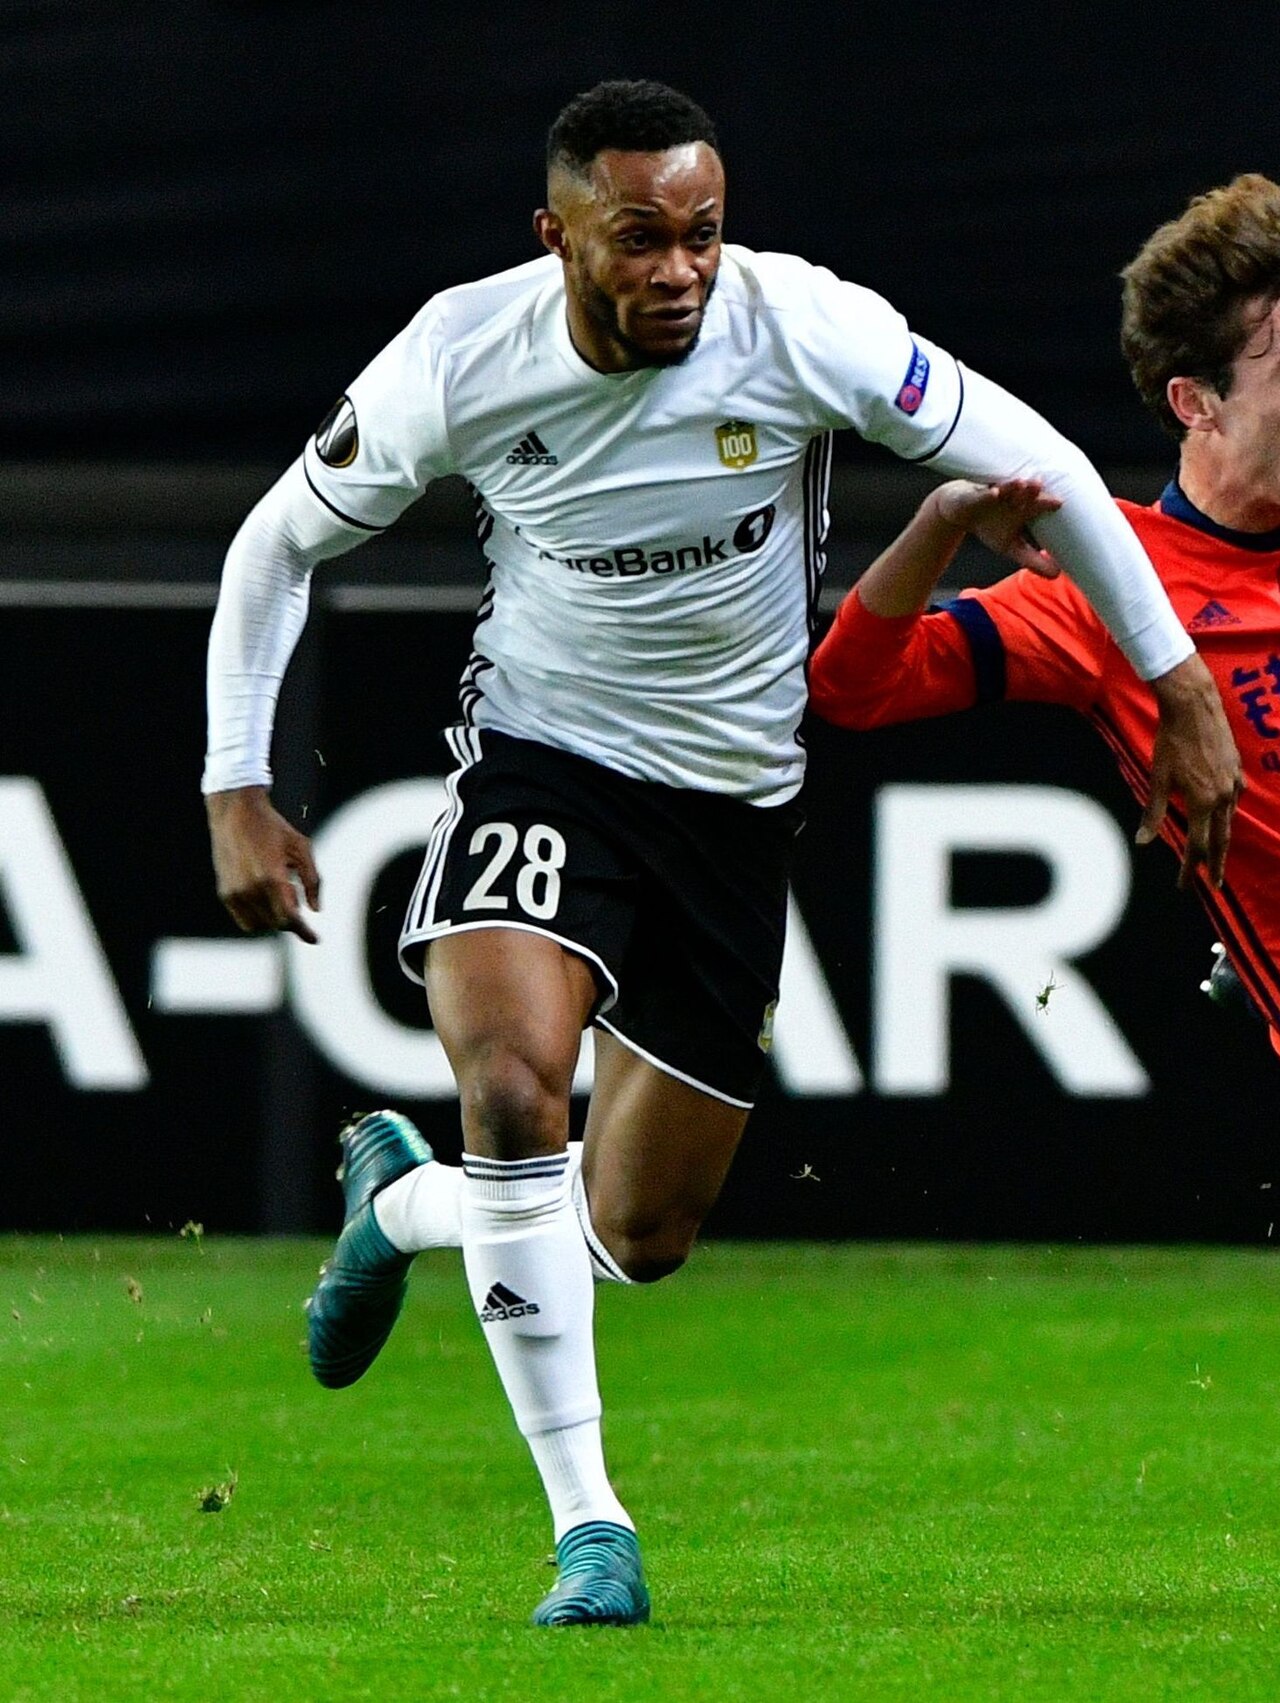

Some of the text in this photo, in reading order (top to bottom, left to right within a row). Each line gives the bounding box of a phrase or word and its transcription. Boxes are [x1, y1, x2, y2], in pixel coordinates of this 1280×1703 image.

[506, 453, 558, 465] adidas
[722, 433, 752, 460] 100
[515, 525, 727, 577] reBank
[463, 822, 566, 920] 28
